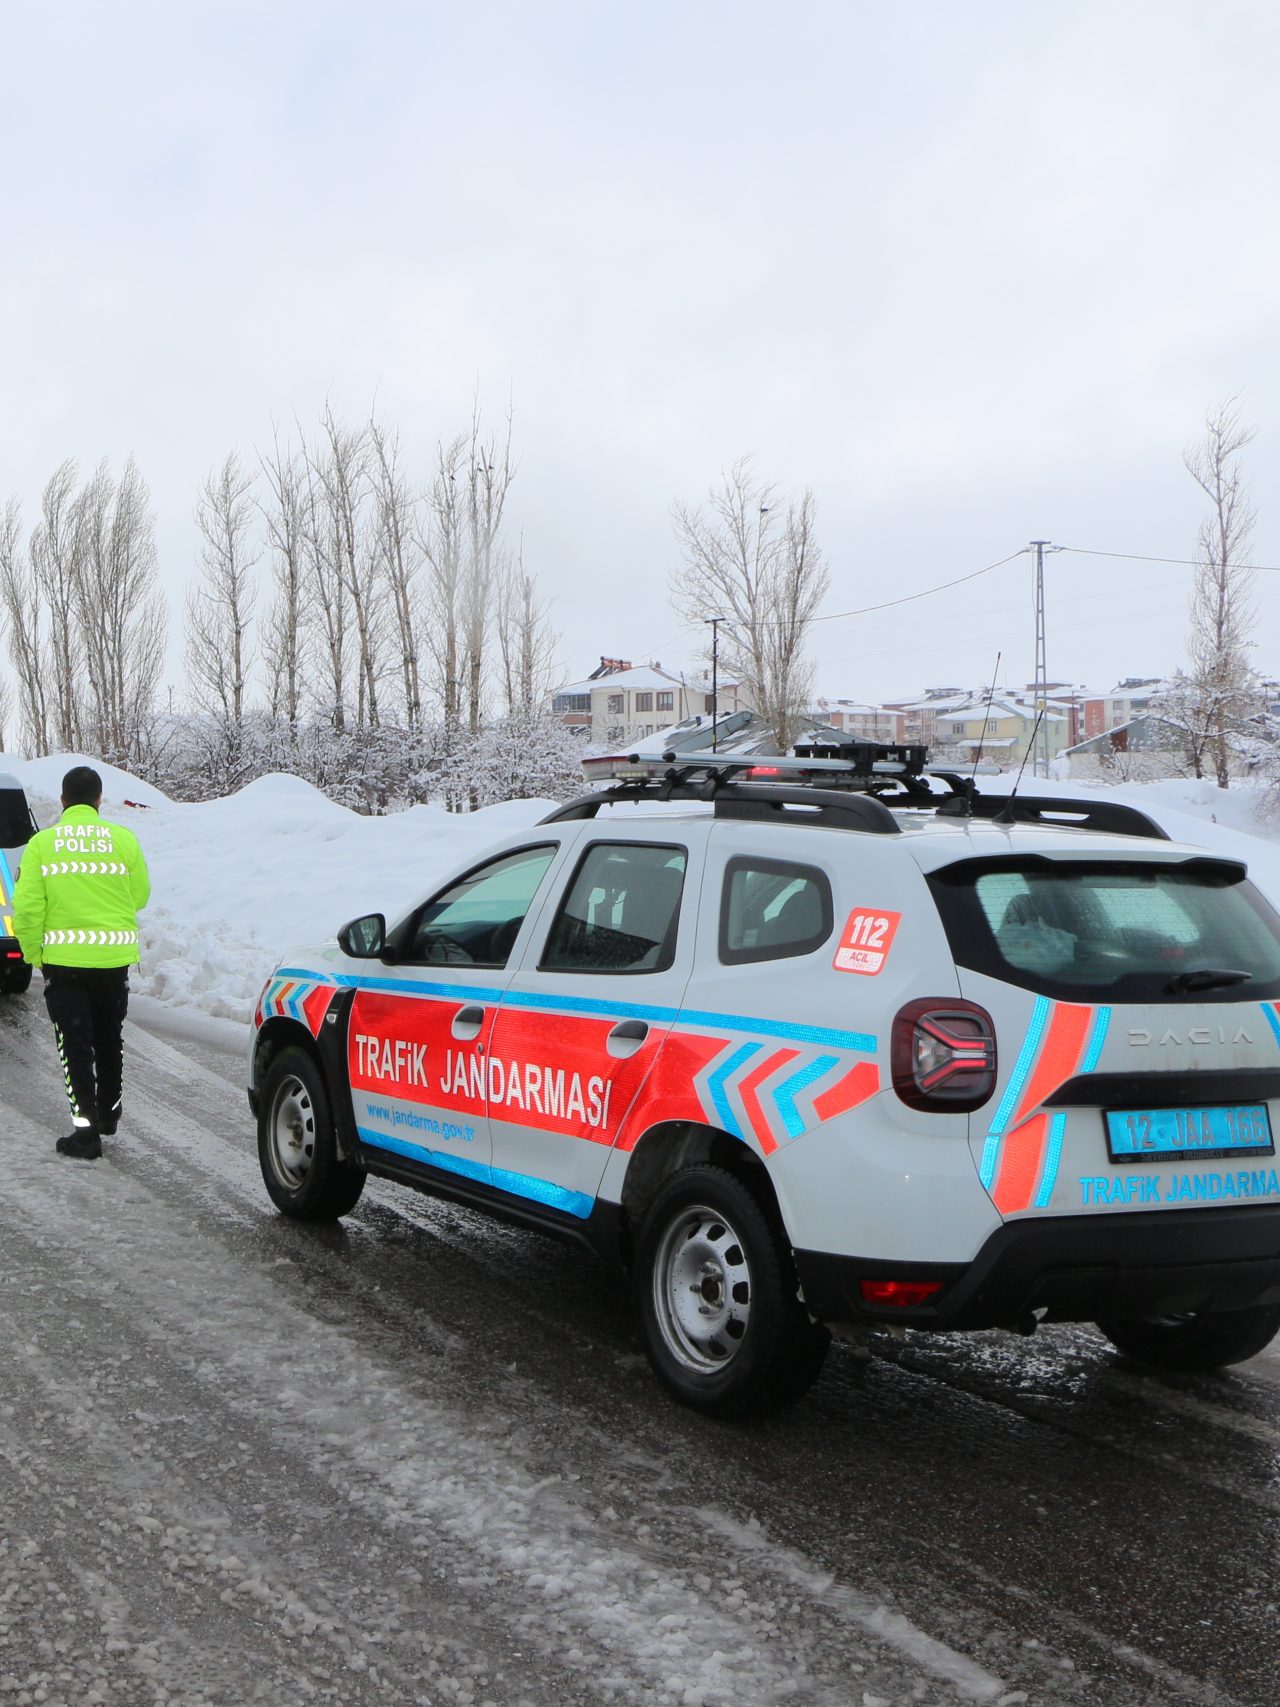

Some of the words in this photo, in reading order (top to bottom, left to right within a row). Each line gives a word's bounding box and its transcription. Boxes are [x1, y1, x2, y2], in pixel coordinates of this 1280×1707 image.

[850, 915, 889, 948] 112
[1127, 1026, 1255, 1047] DACIA
[440, 1049, 612, 1130] JANDARMASI
[366, 1103, 475, 1142] www.jandarma.gov.tr
[1126, 1115, 1156, 1149] 12
[1171, 1112, 1215, 1147] JAA
[1225, 1109, 1267, 1144] 166
